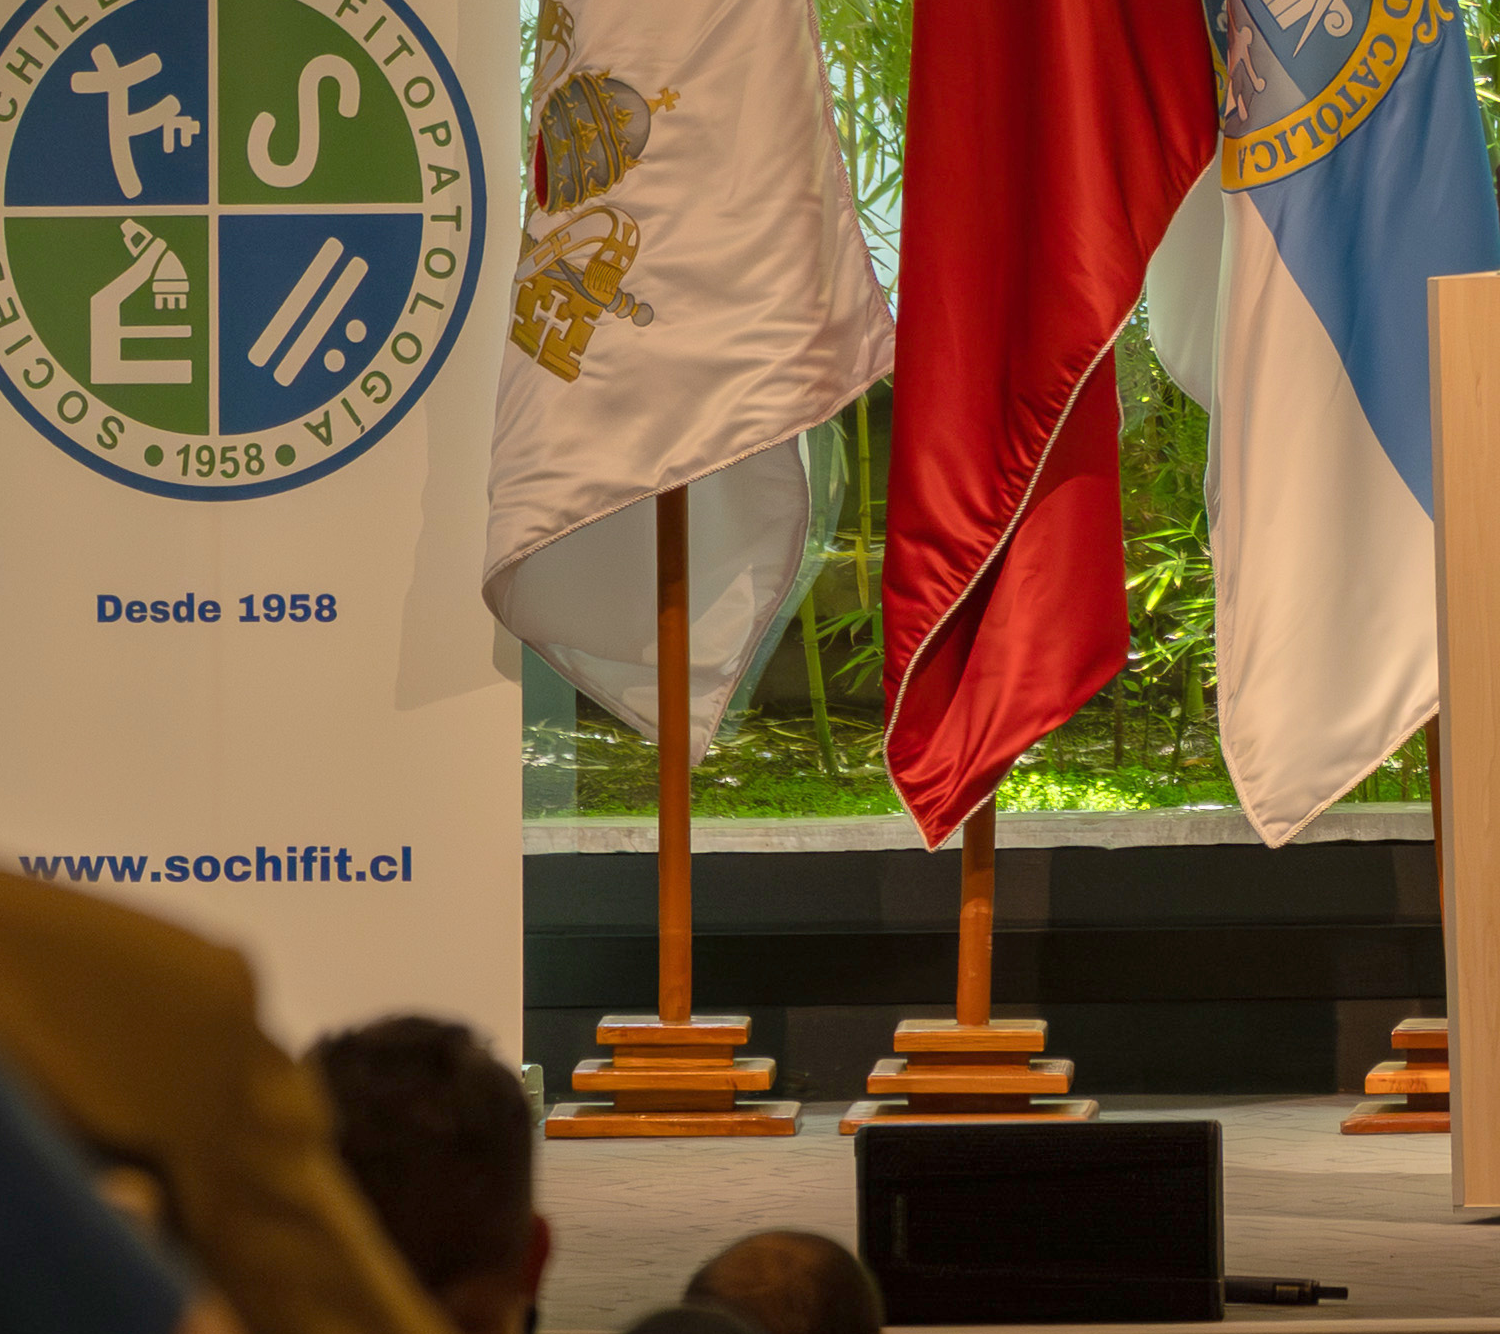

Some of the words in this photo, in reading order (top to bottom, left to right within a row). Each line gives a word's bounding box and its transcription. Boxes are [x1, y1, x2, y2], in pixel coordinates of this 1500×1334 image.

[175, 443, 266, 479] 1958
[96, 592, 222, 624] Desde
[237, 593, 338, 624] 1958
[18, 845, 413, 883] www.sochifit.cl
